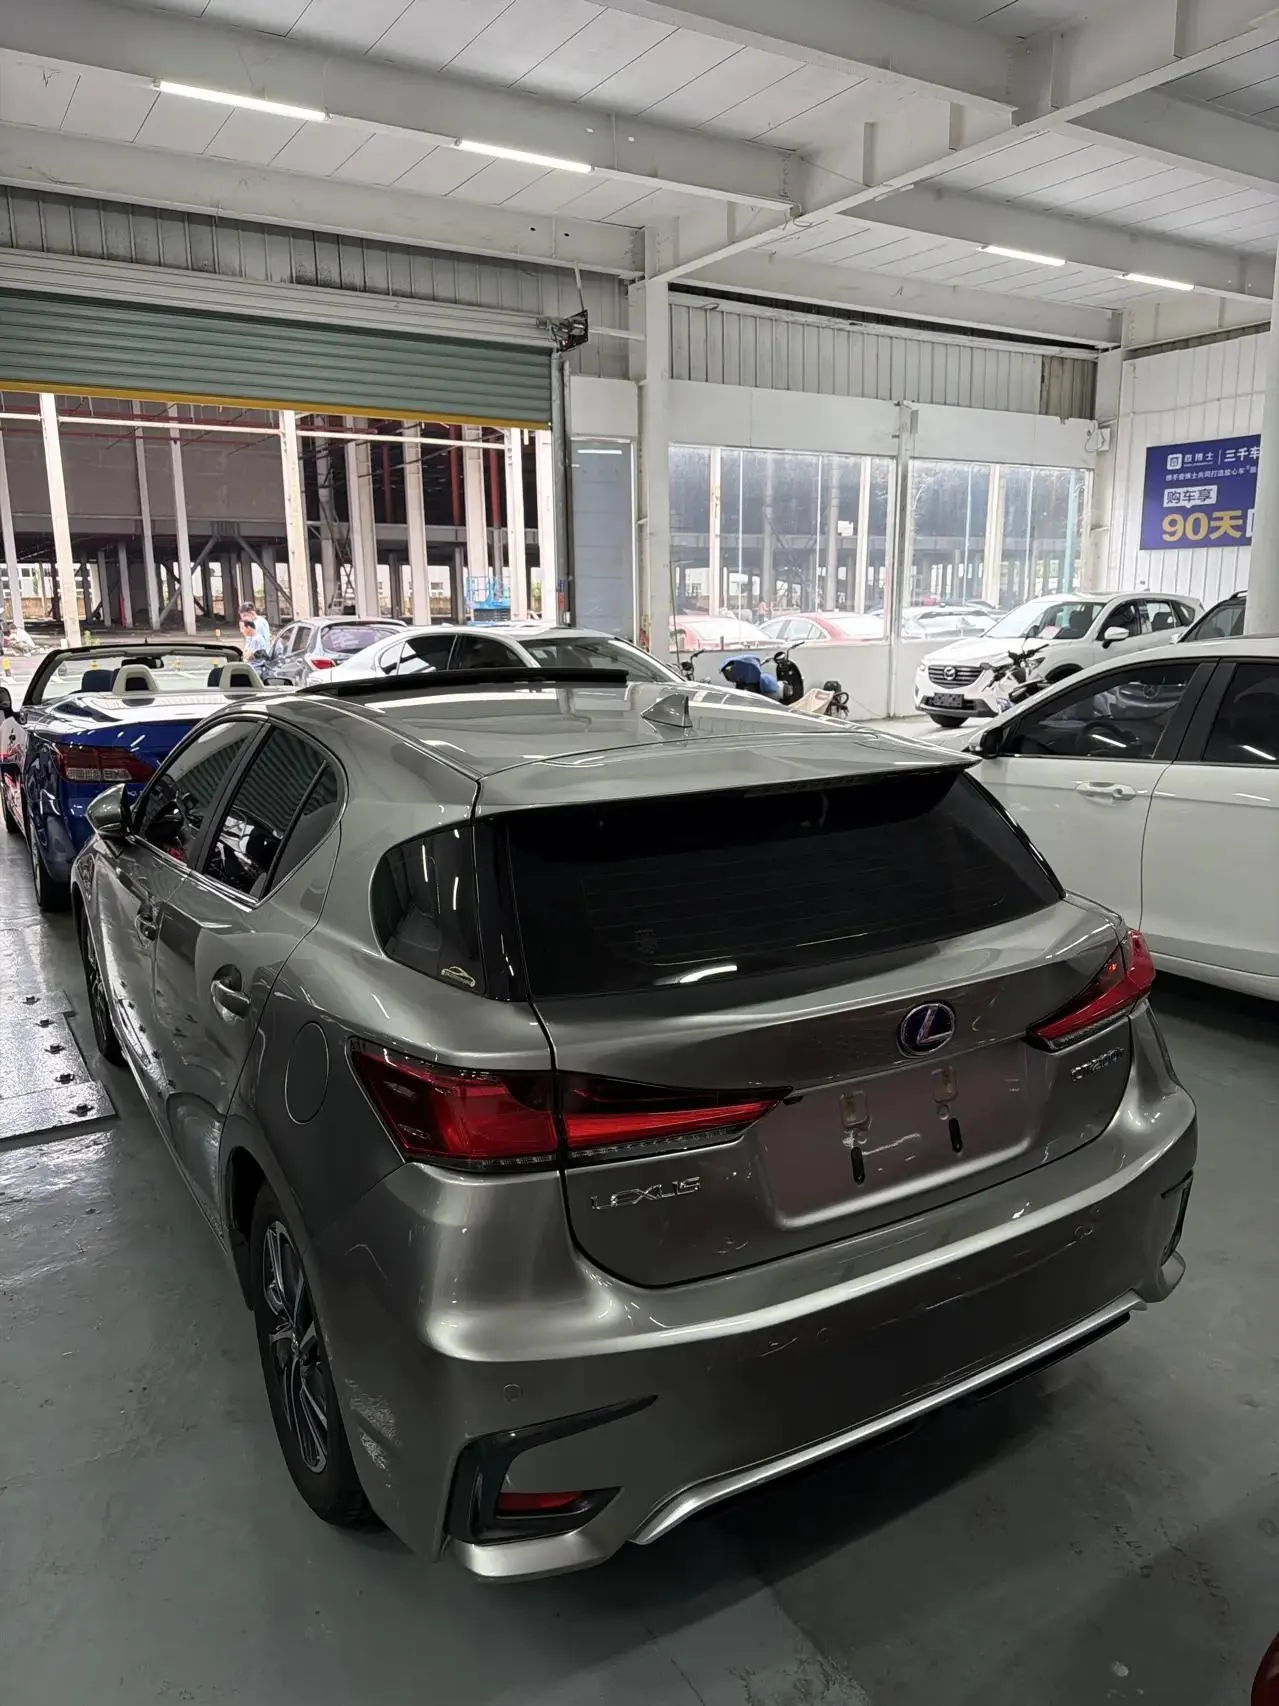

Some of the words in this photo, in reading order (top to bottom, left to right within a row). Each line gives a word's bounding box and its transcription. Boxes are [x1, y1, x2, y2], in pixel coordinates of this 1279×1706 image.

[1165, 488, 1213, 505] 购车享
[1161, 508, 1256, 543] 90天
[590, 1176, 701, 1210] LEXUS
